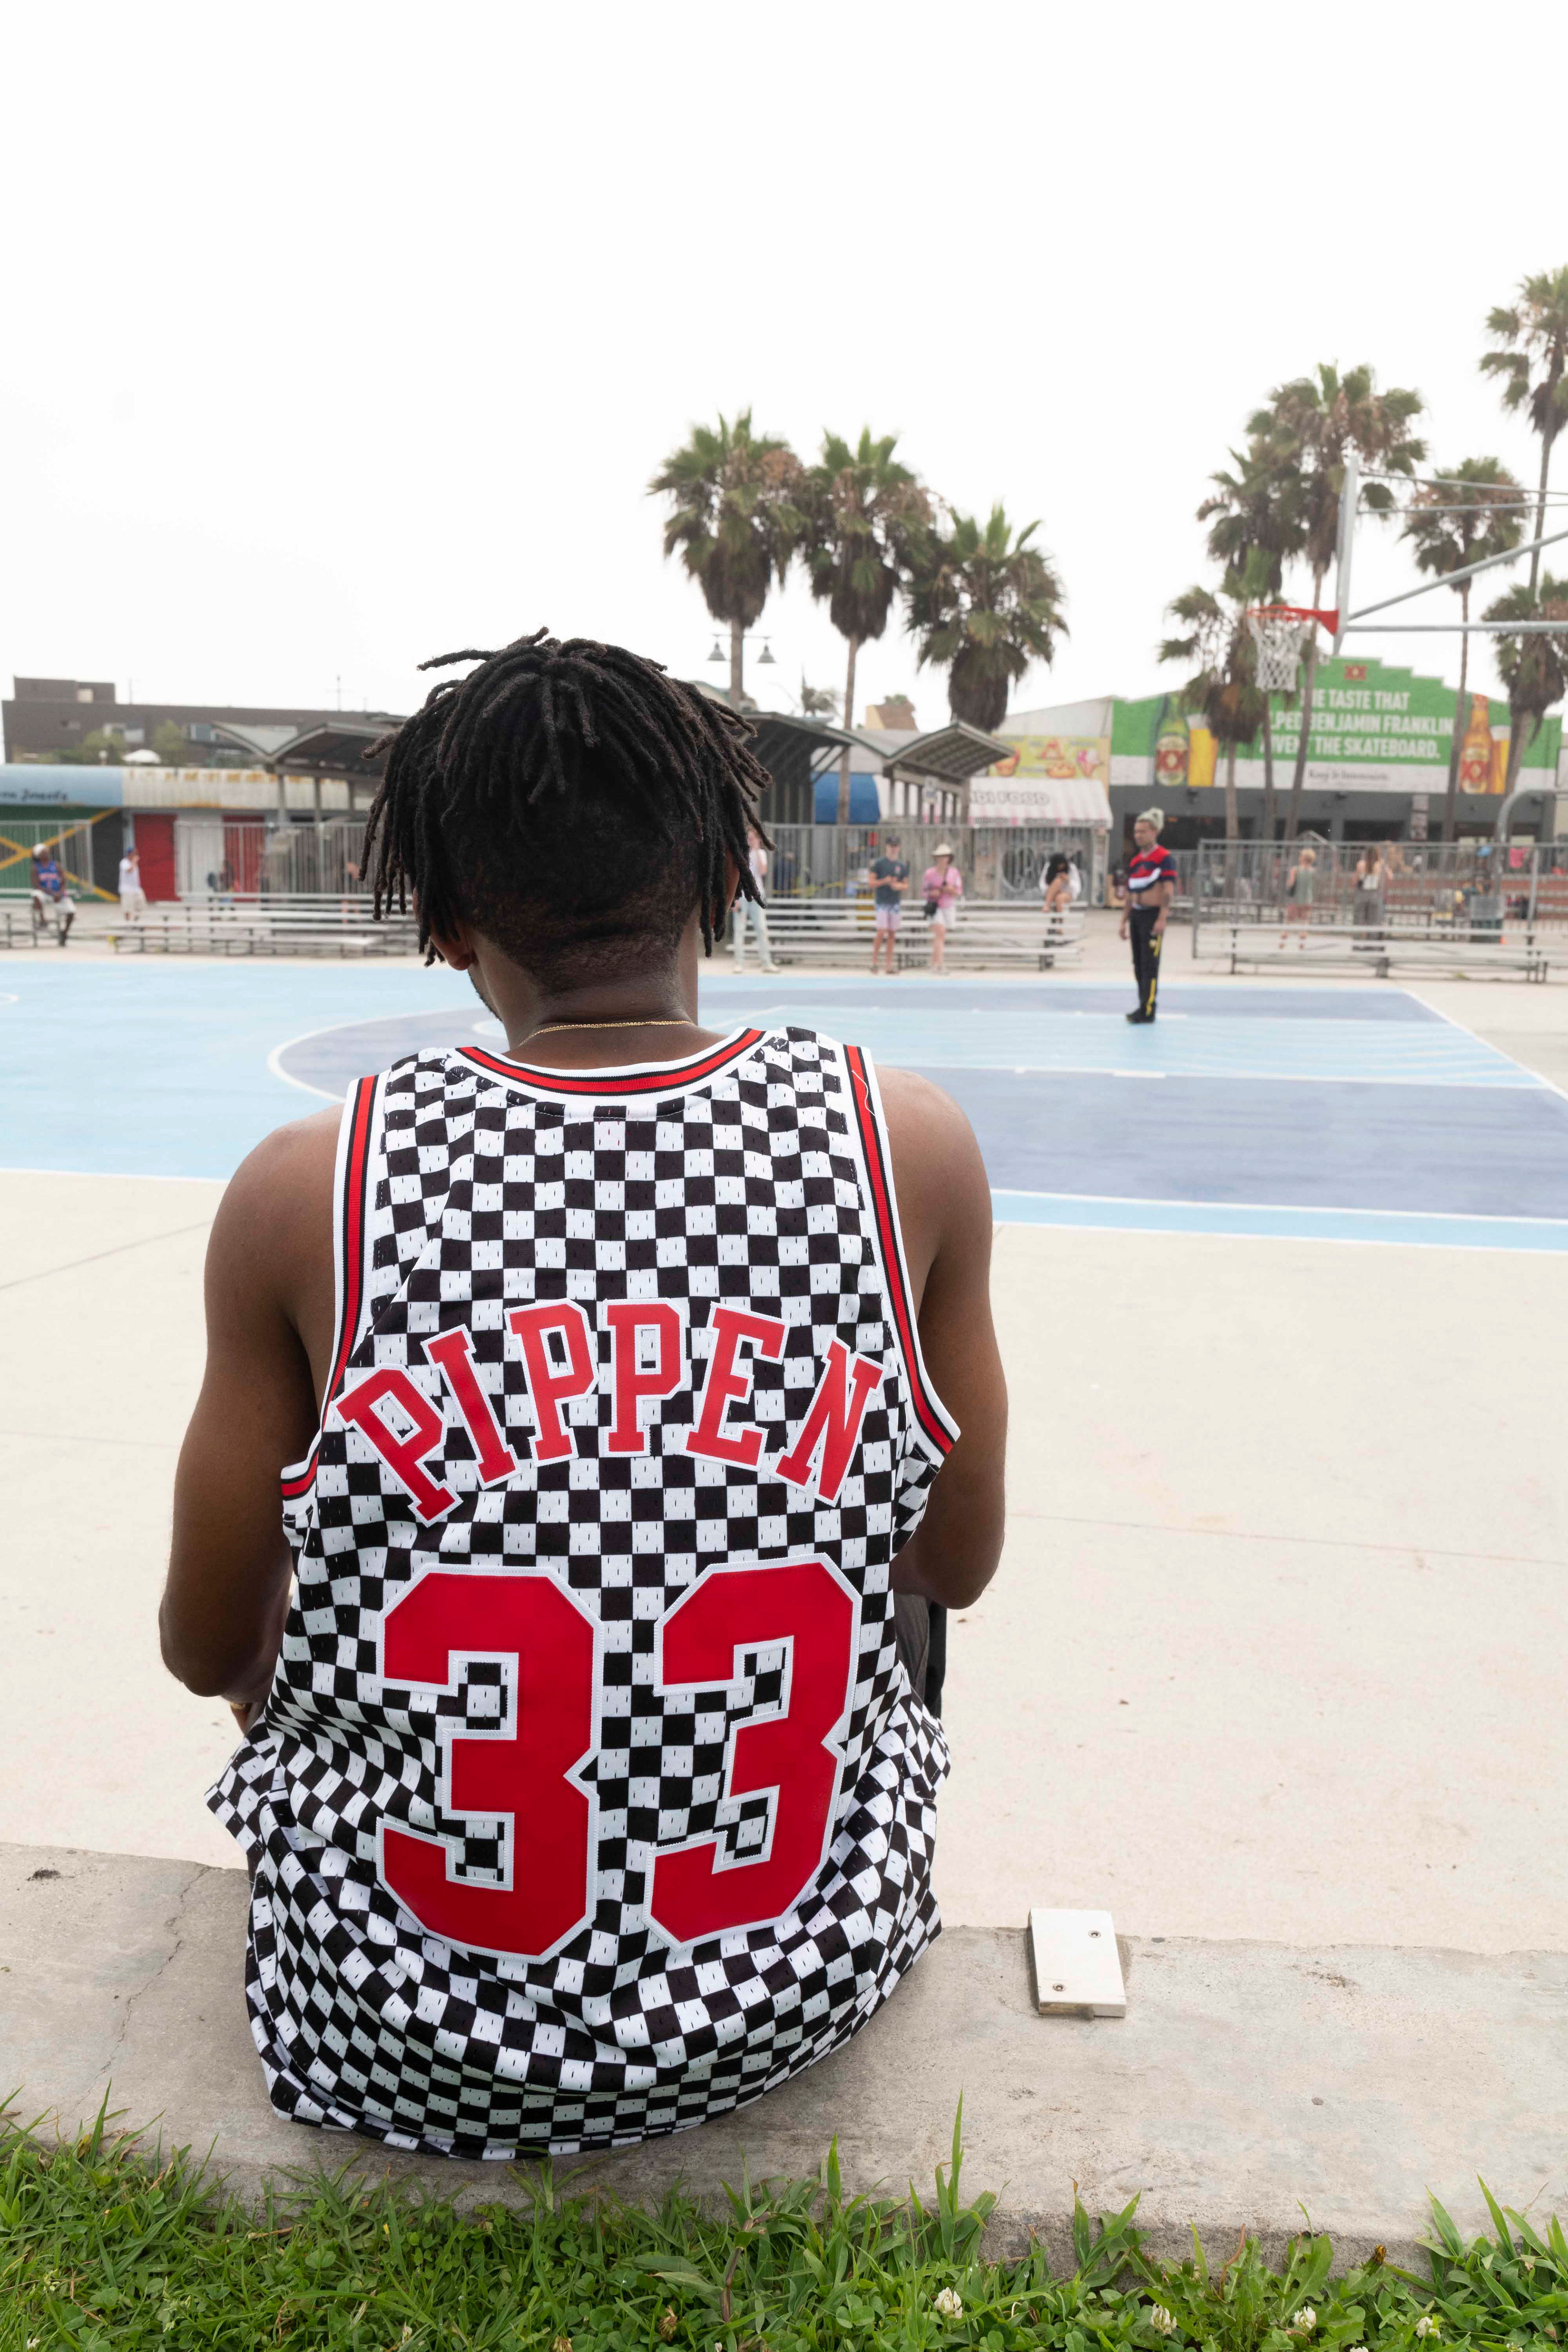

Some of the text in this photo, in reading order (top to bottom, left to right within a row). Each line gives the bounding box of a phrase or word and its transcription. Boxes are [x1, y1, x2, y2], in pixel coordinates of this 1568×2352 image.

[1328, 690, 1371, 709] TASTE
[1375, 691, 1411, 710] THAT
[1269, 710, 1454, 735] LPED BENJAMIN FRANKLIN
[1260, 734, 1441, 759] IVEN THE SKATEBOARD.
[332, 1297, 888, 1528] PIPPEN
[376, 1553, 862, 1964] 33
